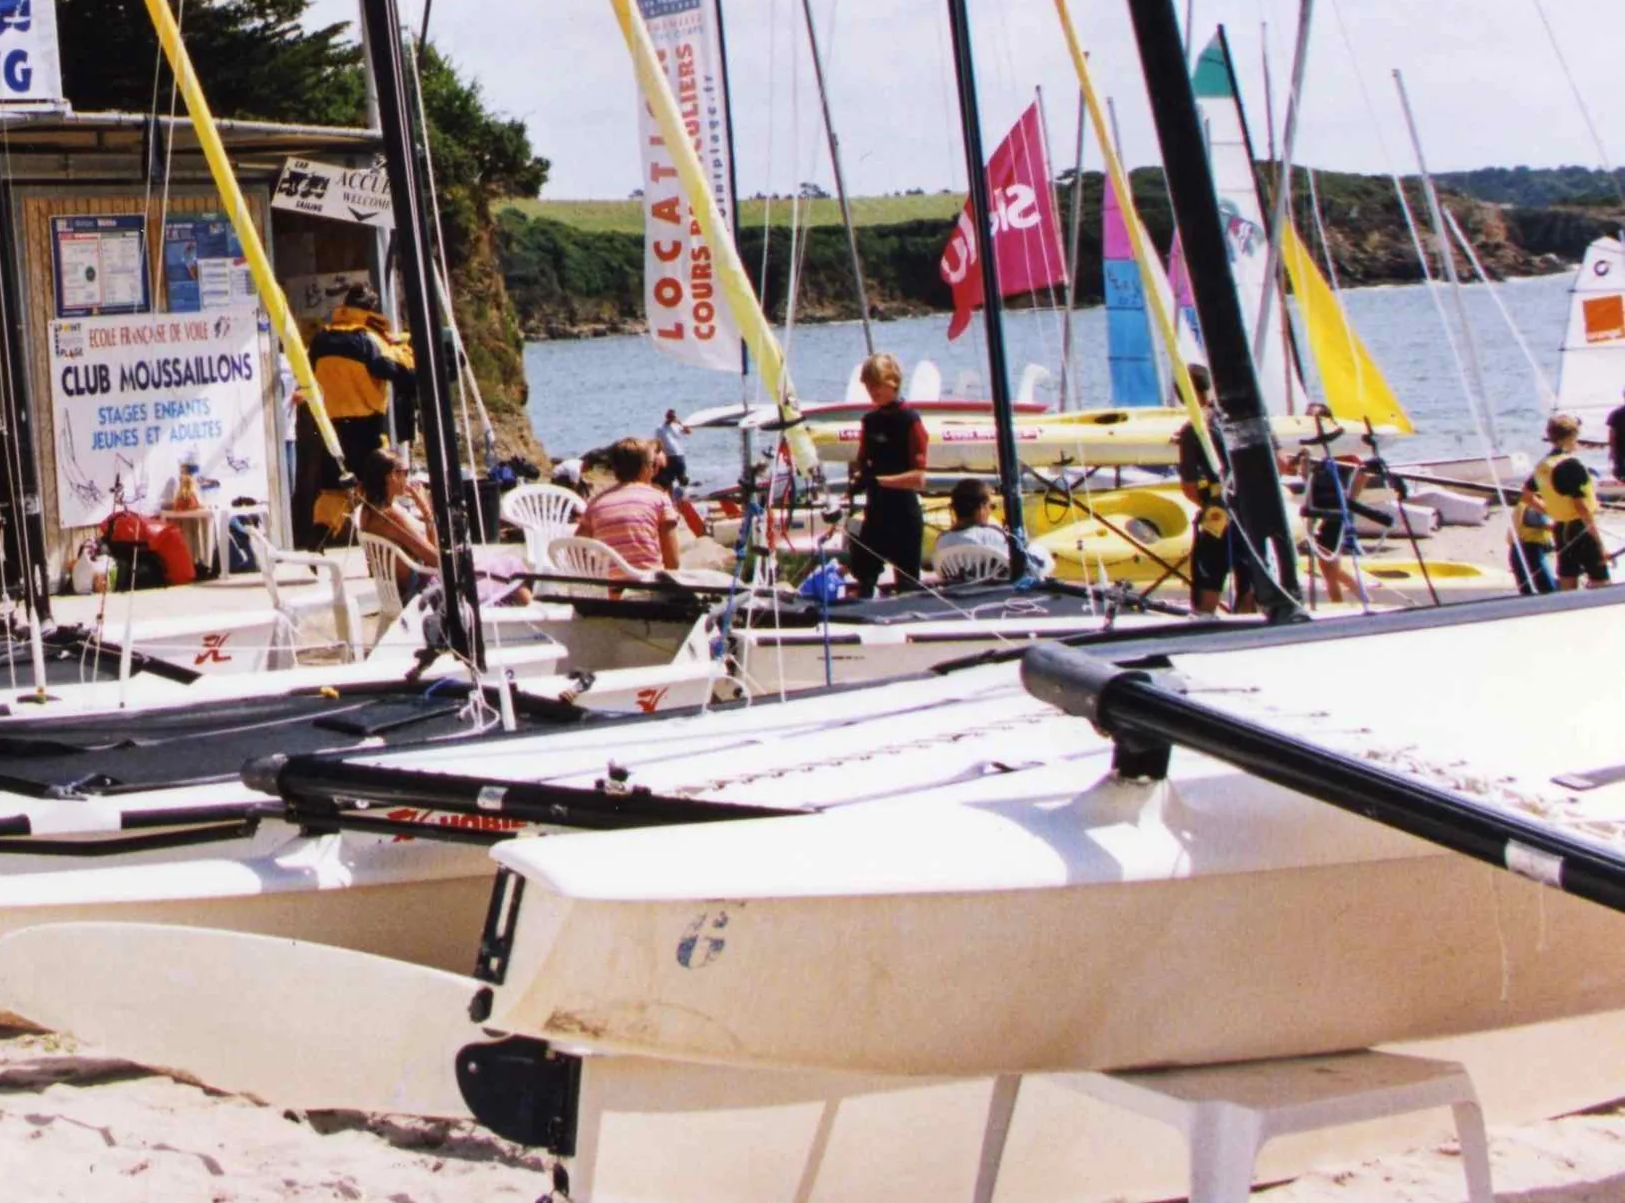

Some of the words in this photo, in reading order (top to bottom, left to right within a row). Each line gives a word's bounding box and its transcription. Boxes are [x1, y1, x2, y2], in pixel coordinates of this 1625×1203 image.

[646, 48, 685, 342] LOCATI
[690, 245, 717, 341] COURS
[88, 327, 117, 349] ECOLE
[170, 323, 181, 342] DE
[185, 321, 209, 340] VOILE
[61, 363, 111, 397] CLUB
[120, 352, 253, 393] MOUSSAILLONS
[98, 400, 147, 425] STAGES
[154, 397, 210, 421] ENFANTS
[91, 429, 139, 451] JEUNES
[146, 426, 161, 444] ET
[170, 420, 223, 443] ADULTES
